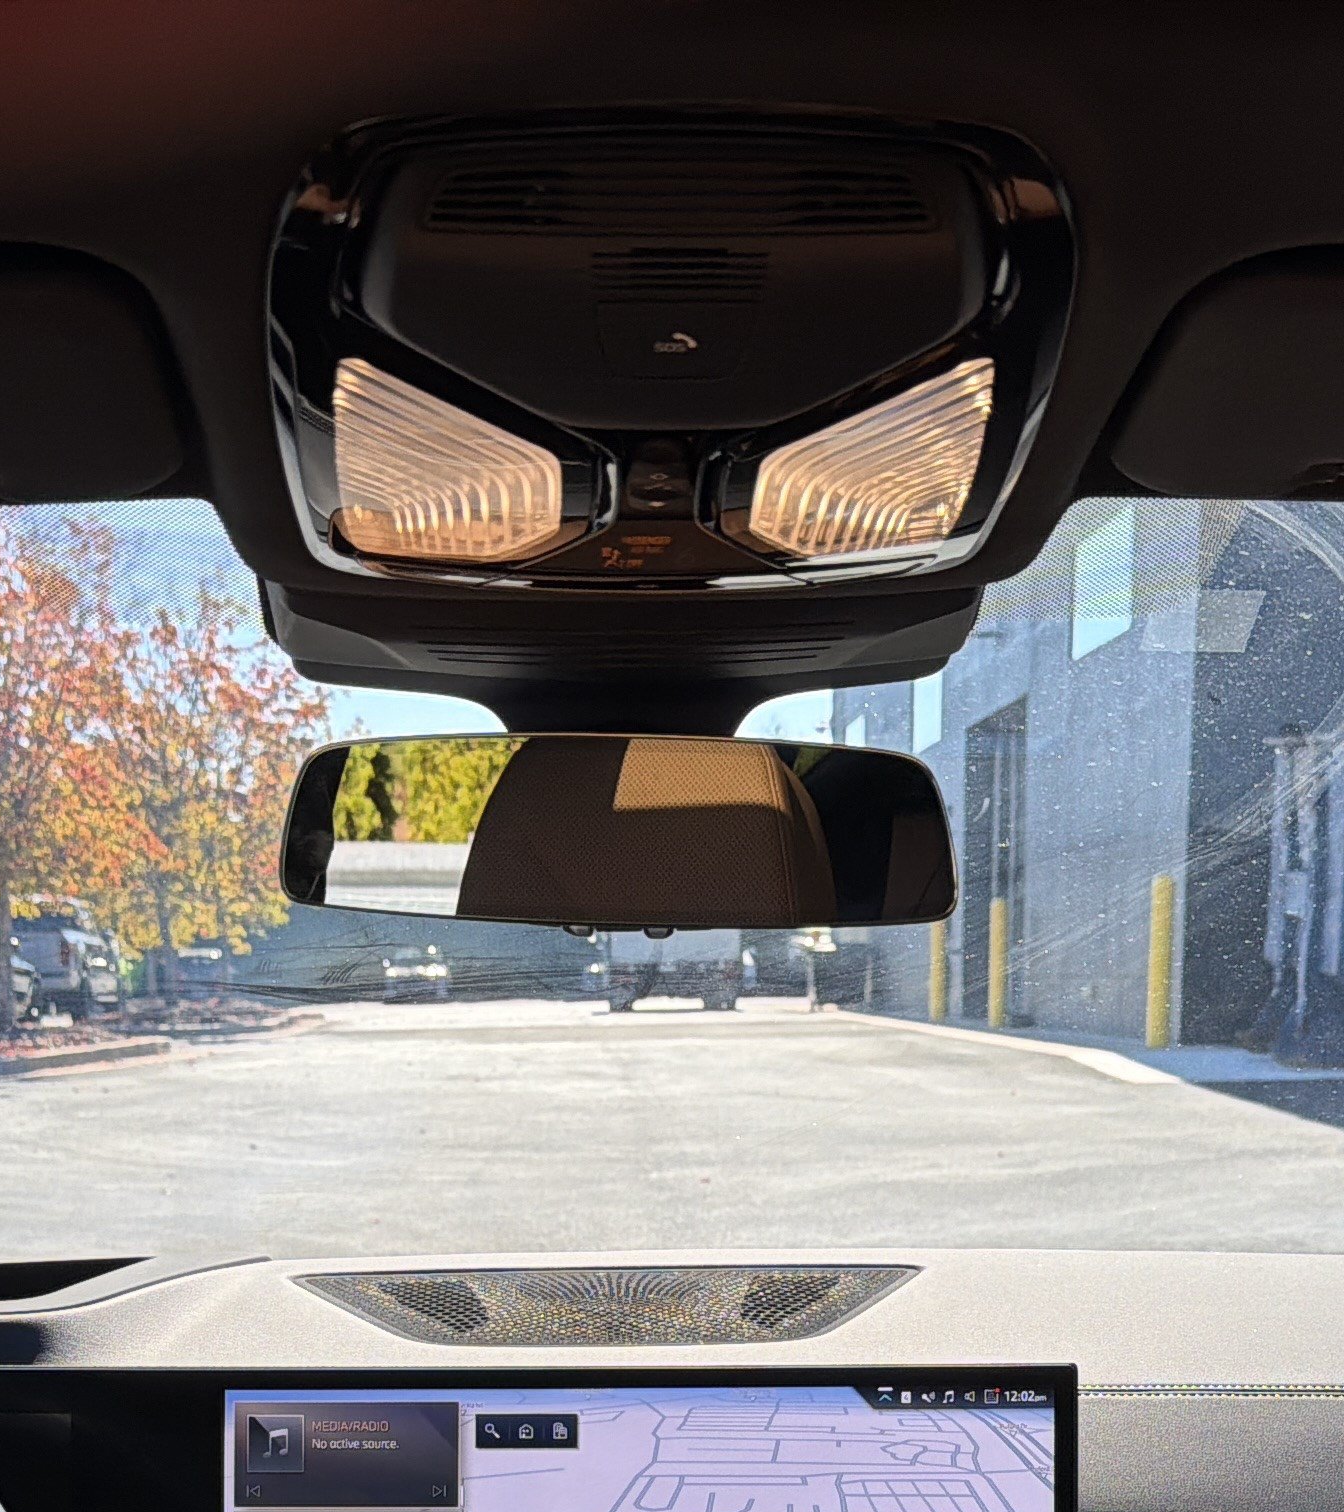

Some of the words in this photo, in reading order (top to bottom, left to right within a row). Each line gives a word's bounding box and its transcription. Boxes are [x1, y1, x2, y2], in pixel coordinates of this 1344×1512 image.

[312, 1420, 389, 1432] MEDIA/RADIO
[311, 1438, 328, 1449] No
[329, 1438, 360, 1449] active
